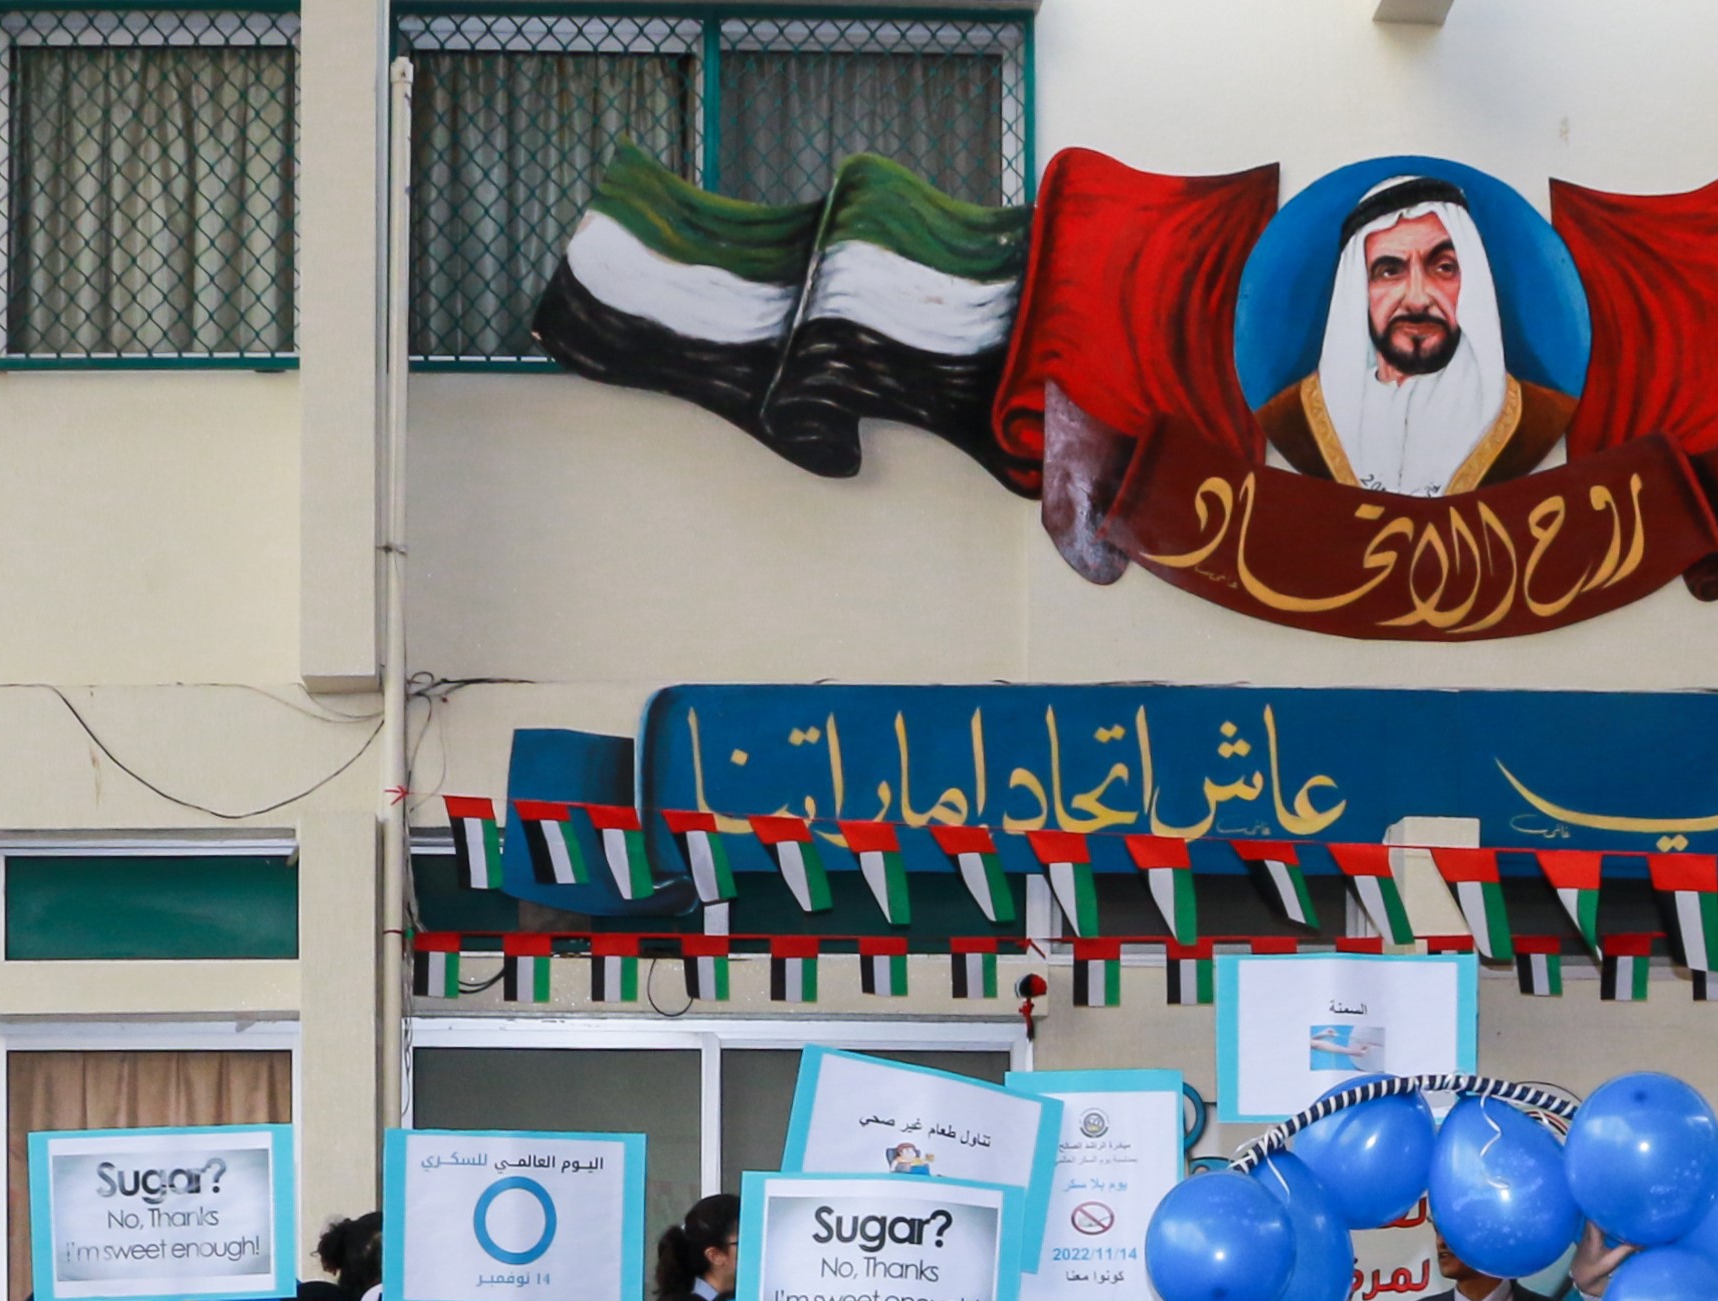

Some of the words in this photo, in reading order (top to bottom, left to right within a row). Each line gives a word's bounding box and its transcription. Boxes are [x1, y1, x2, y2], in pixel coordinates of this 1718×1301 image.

[1150, 703, 1346, 843] عاش
[1329, 1000, 1368, 1015] السمنة
[859, 1113, 895, 1127] صحي
[928, 1123, 956, 1139] طعام
[960, 1133, 991, 1148] تناول
[96, 1157, 227, 1205] Sugar?
[107, 1209, 144, 1230] No,
[148, 1206, 220, 1228] Thanks
[812, 1205, 953, 1253] Sugar?
[104, 1239, 166, 1261] sweet
[171, 1235, 260, 1262] enough!
[1052, 1247, 1138, 1262] 2022/11/14
[820, 1256, 858, 1280] No,
[863, 1256, 940, 1282] Thanks
